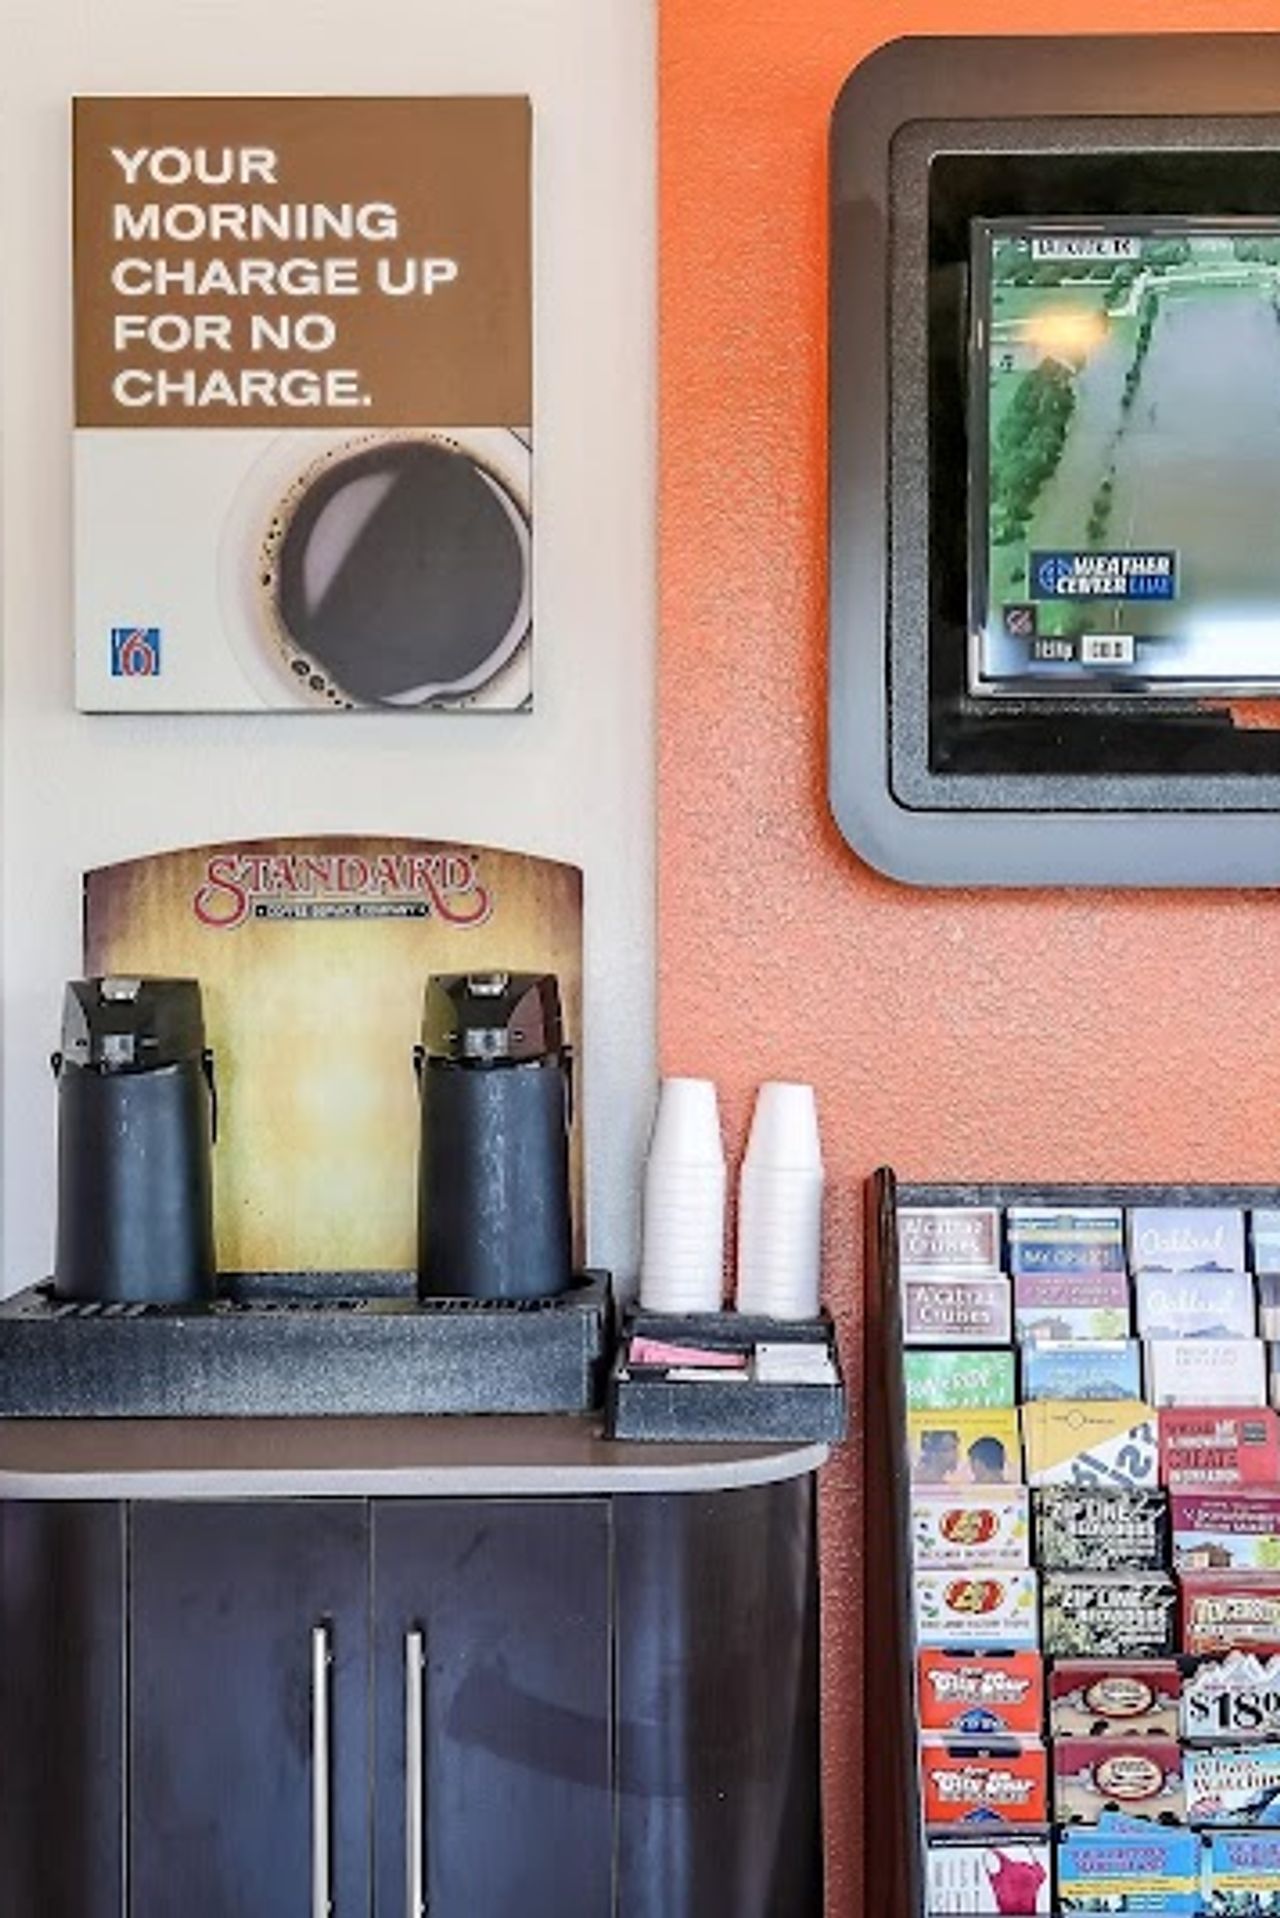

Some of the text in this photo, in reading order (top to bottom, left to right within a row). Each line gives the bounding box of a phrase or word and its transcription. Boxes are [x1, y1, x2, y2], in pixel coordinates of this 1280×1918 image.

[111, 147, 278, 184] YOUR
[112, 203, 399, 241] MORNING
[111, 258, 458, 296] CHARGE UP
[113, 314, 336, 351] FOR NO
[111, 369, 372, 406] CHARGE.
[1074, 556, 1170, 575] WEATHER
[1056, 577, 1127, 595] CENTER
[193, 855, 490, 929] STANDARD
